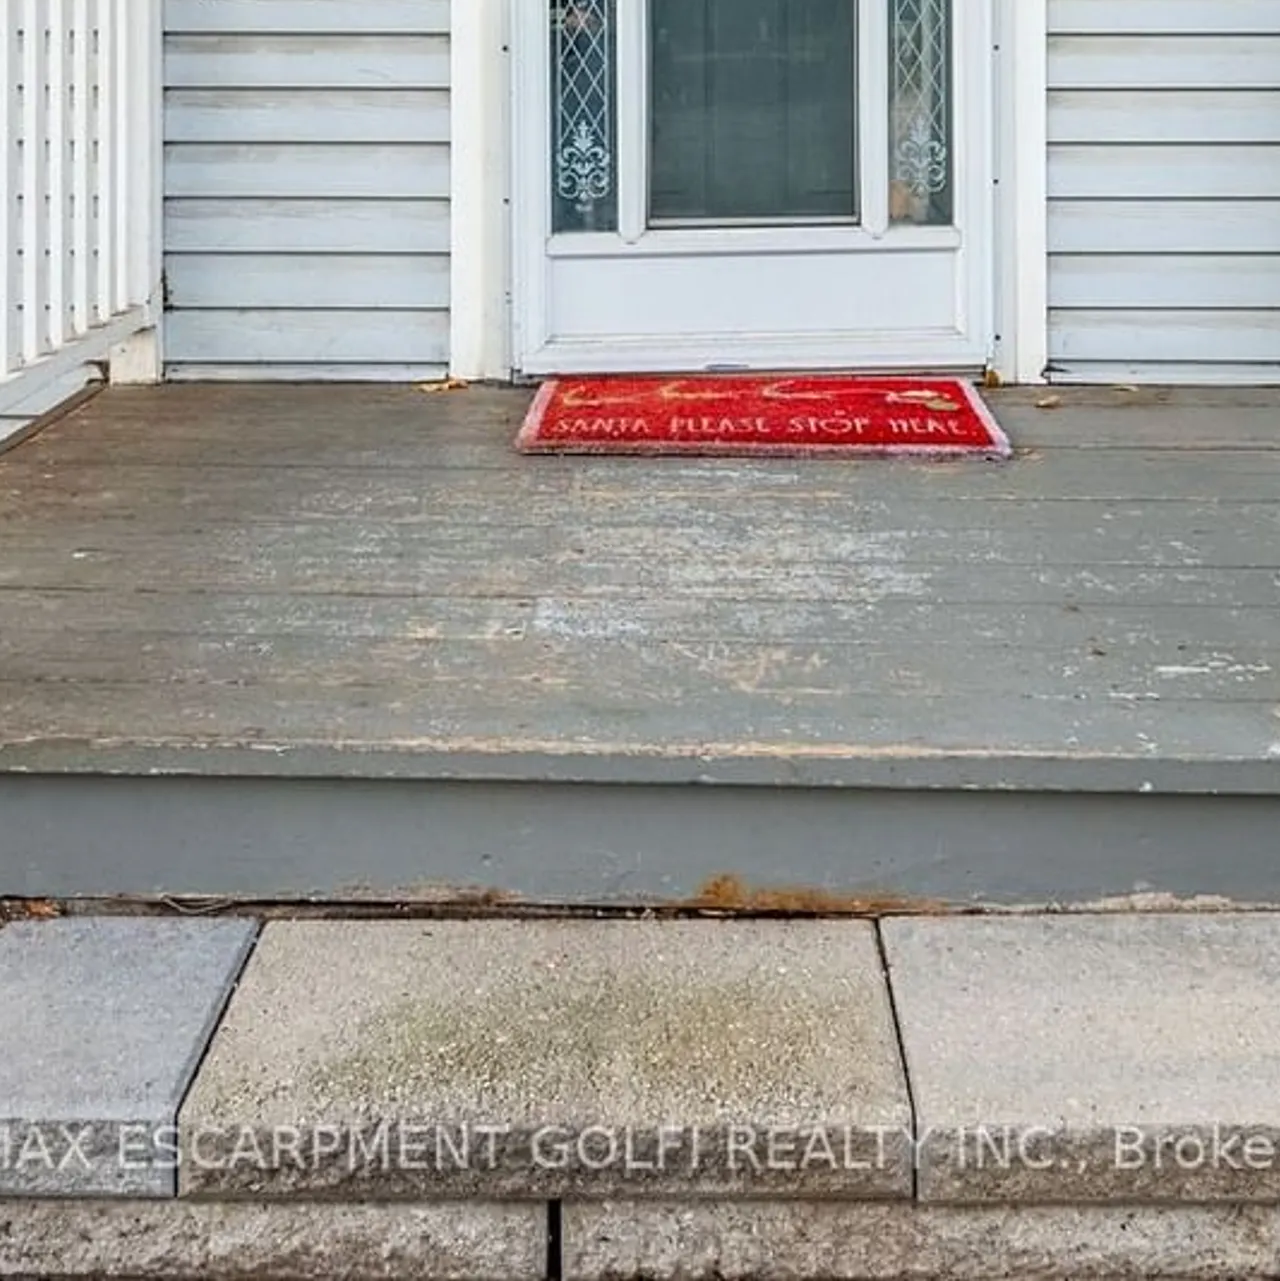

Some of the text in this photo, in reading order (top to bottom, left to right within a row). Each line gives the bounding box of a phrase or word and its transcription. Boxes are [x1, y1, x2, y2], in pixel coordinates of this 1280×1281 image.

[551, 417, 651, 437] SANTA
[669, 417, 770, 433] PLEASE
[787, 409, 869, 434] STOP
